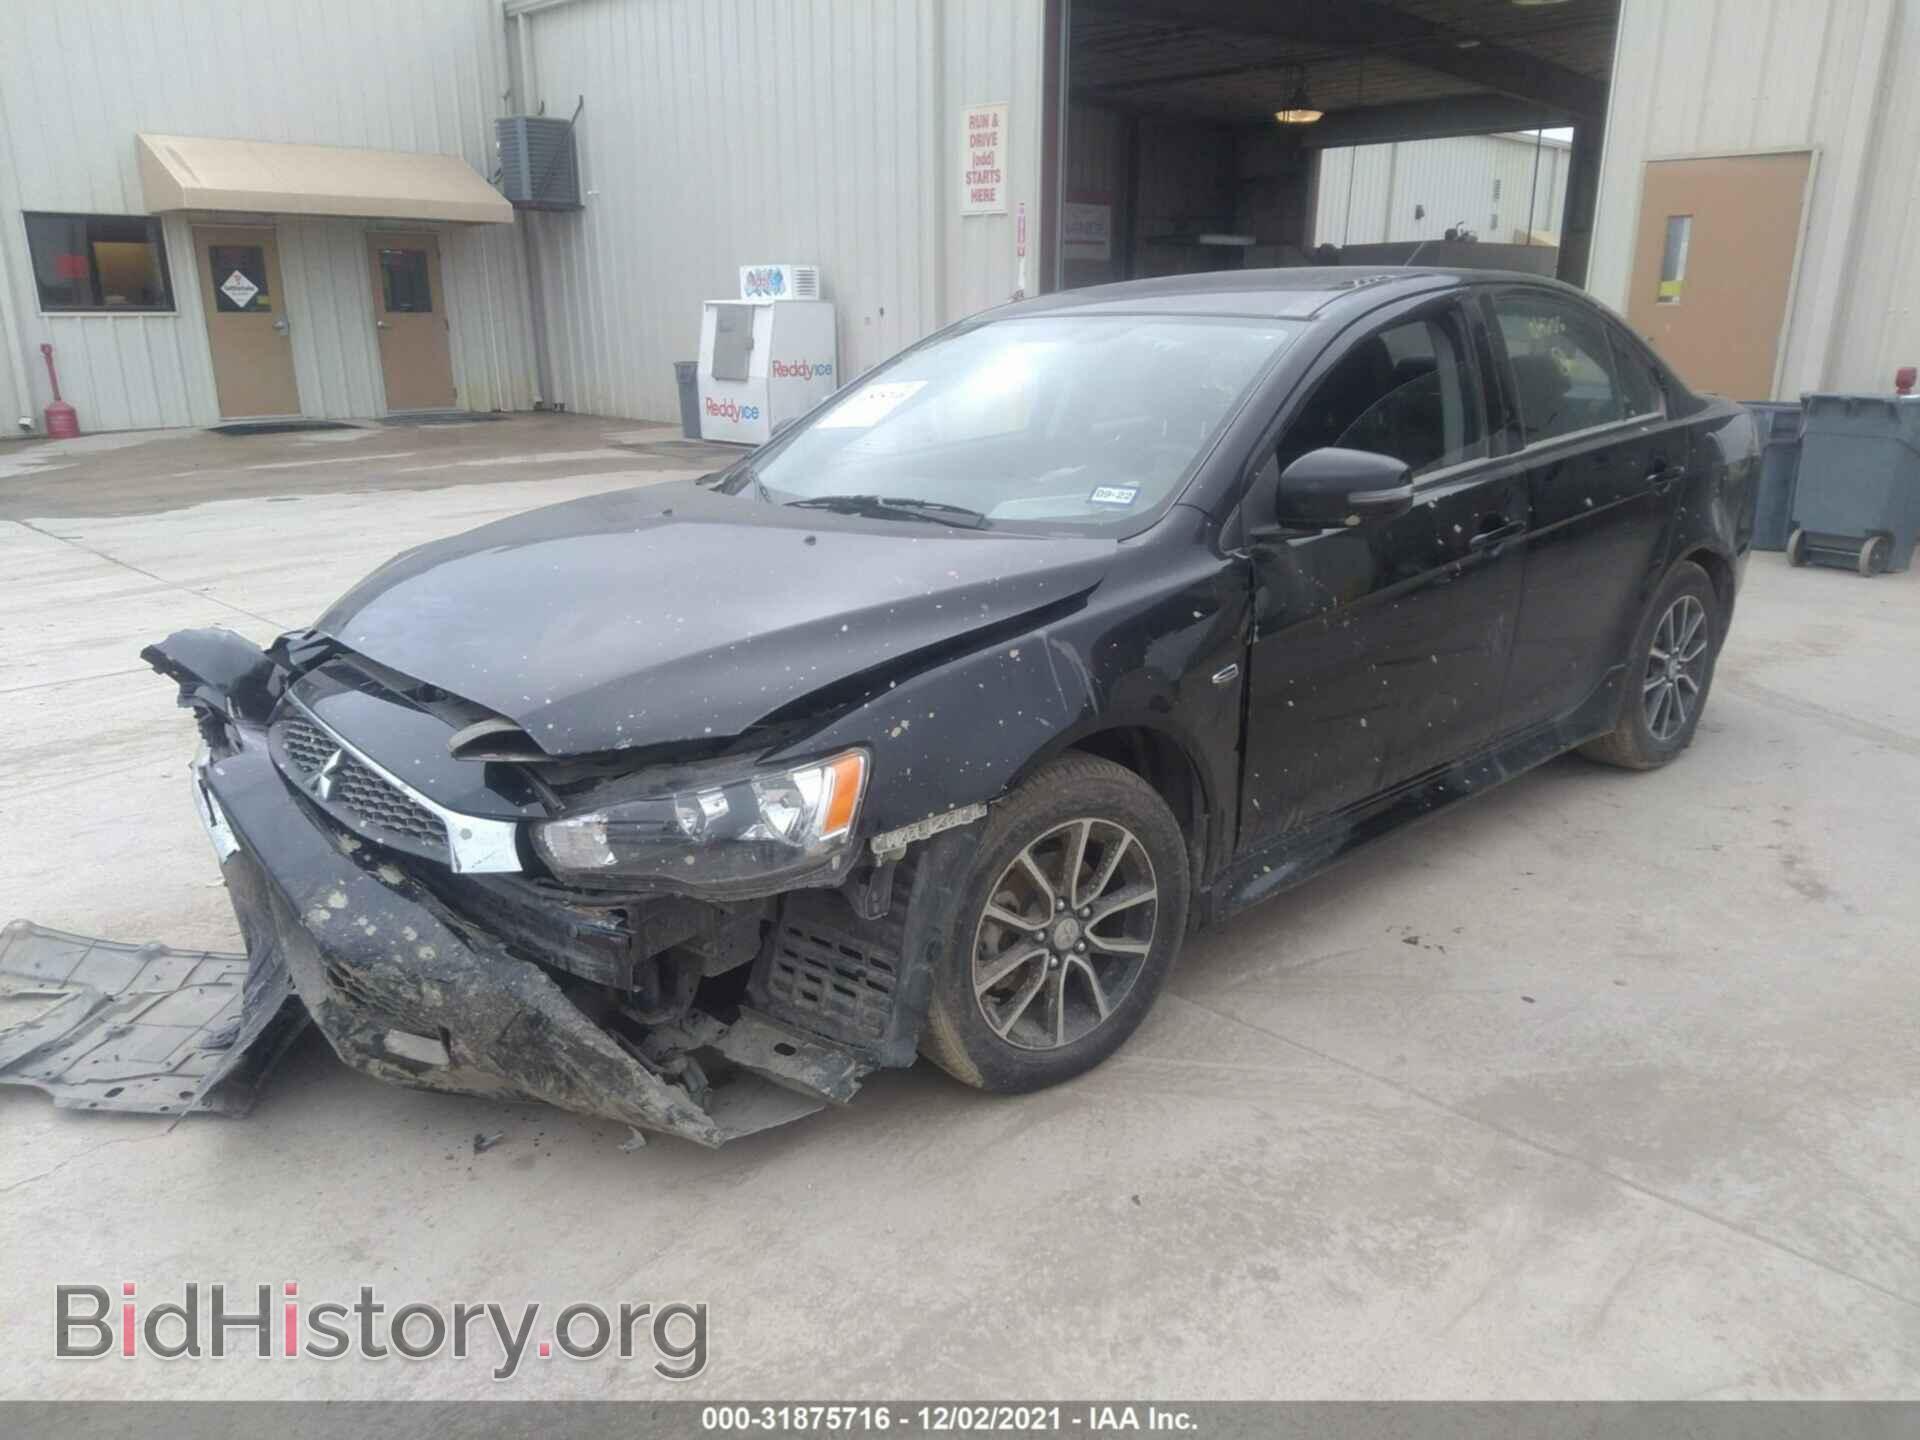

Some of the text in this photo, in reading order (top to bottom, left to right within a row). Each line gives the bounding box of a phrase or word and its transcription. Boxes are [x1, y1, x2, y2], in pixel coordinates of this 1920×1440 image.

[968, 112, 1000, 129] RUN &
[969, 130, 998, 148] DRIVE
[965, 168, 1001, 185] STARTS
[970, 186, 996, 203] HERE
